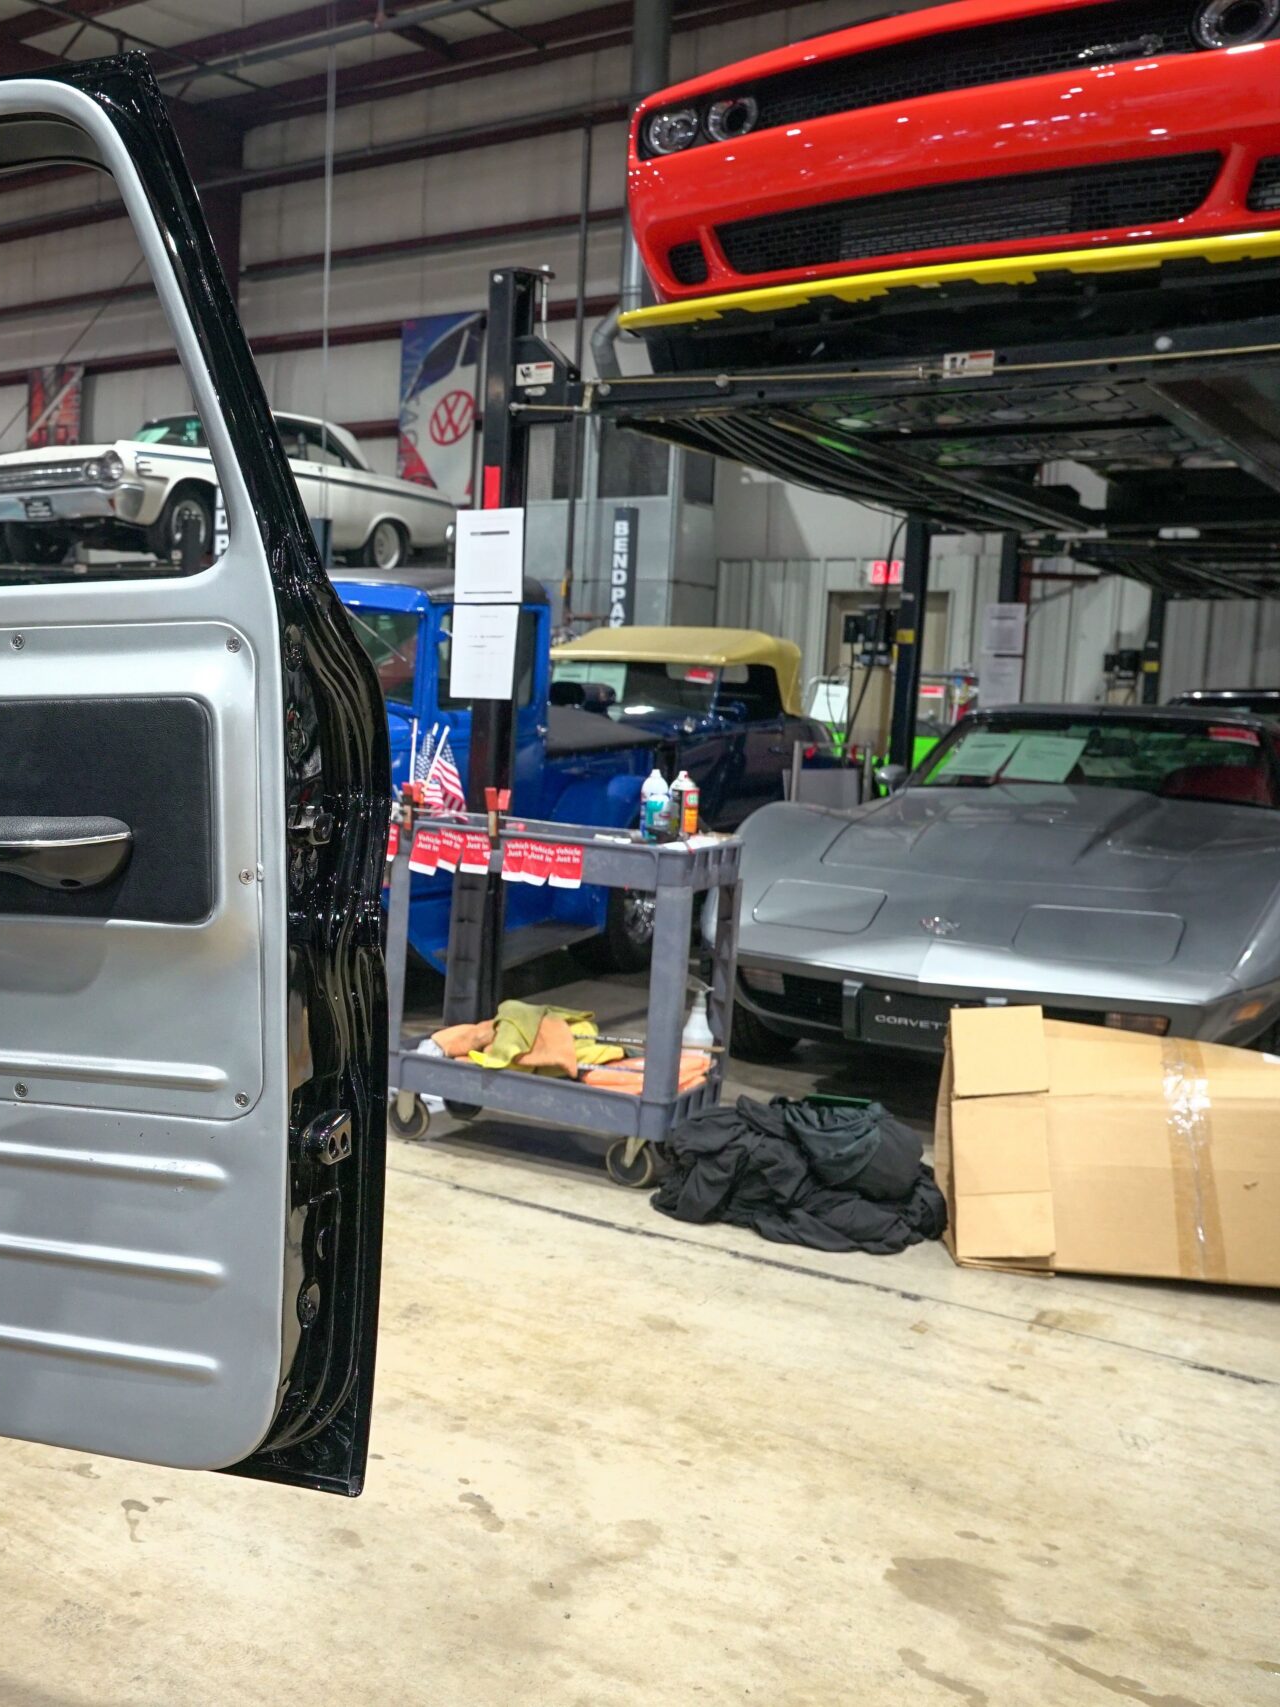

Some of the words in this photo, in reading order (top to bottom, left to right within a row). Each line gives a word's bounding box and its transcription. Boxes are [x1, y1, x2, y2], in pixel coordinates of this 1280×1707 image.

[416, 841, 431, 850] Just
[466, 841, 481, 850] Just
[507, 841, 529, 850] Vehicl
[507, 849, 522, 857] Just
[528, 851, 543, 861] Just
[556, 855, 571, 863] Just
[875, 1014, 948, 1030] CORVET
